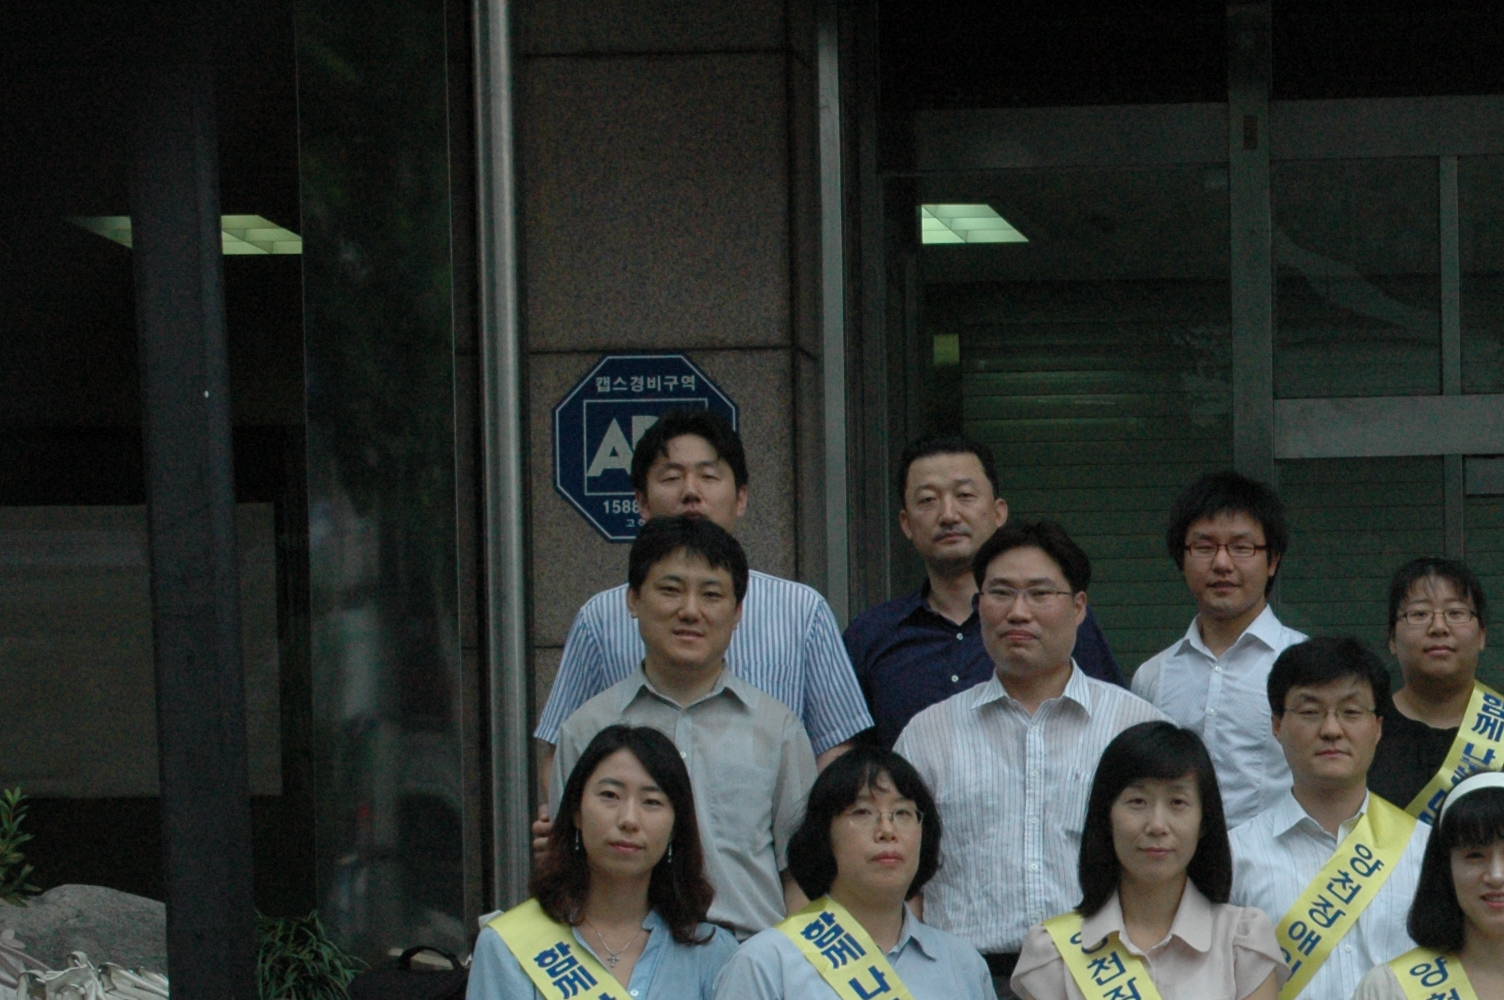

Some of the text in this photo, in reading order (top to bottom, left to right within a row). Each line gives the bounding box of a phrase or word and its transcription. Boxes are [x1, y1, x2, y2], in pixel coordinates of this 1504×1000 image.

[595, 374, 697, 393] 캡스경비구역
[800, 910, 867, 970] 함께
[533, 941, 599, 1000] 함께
